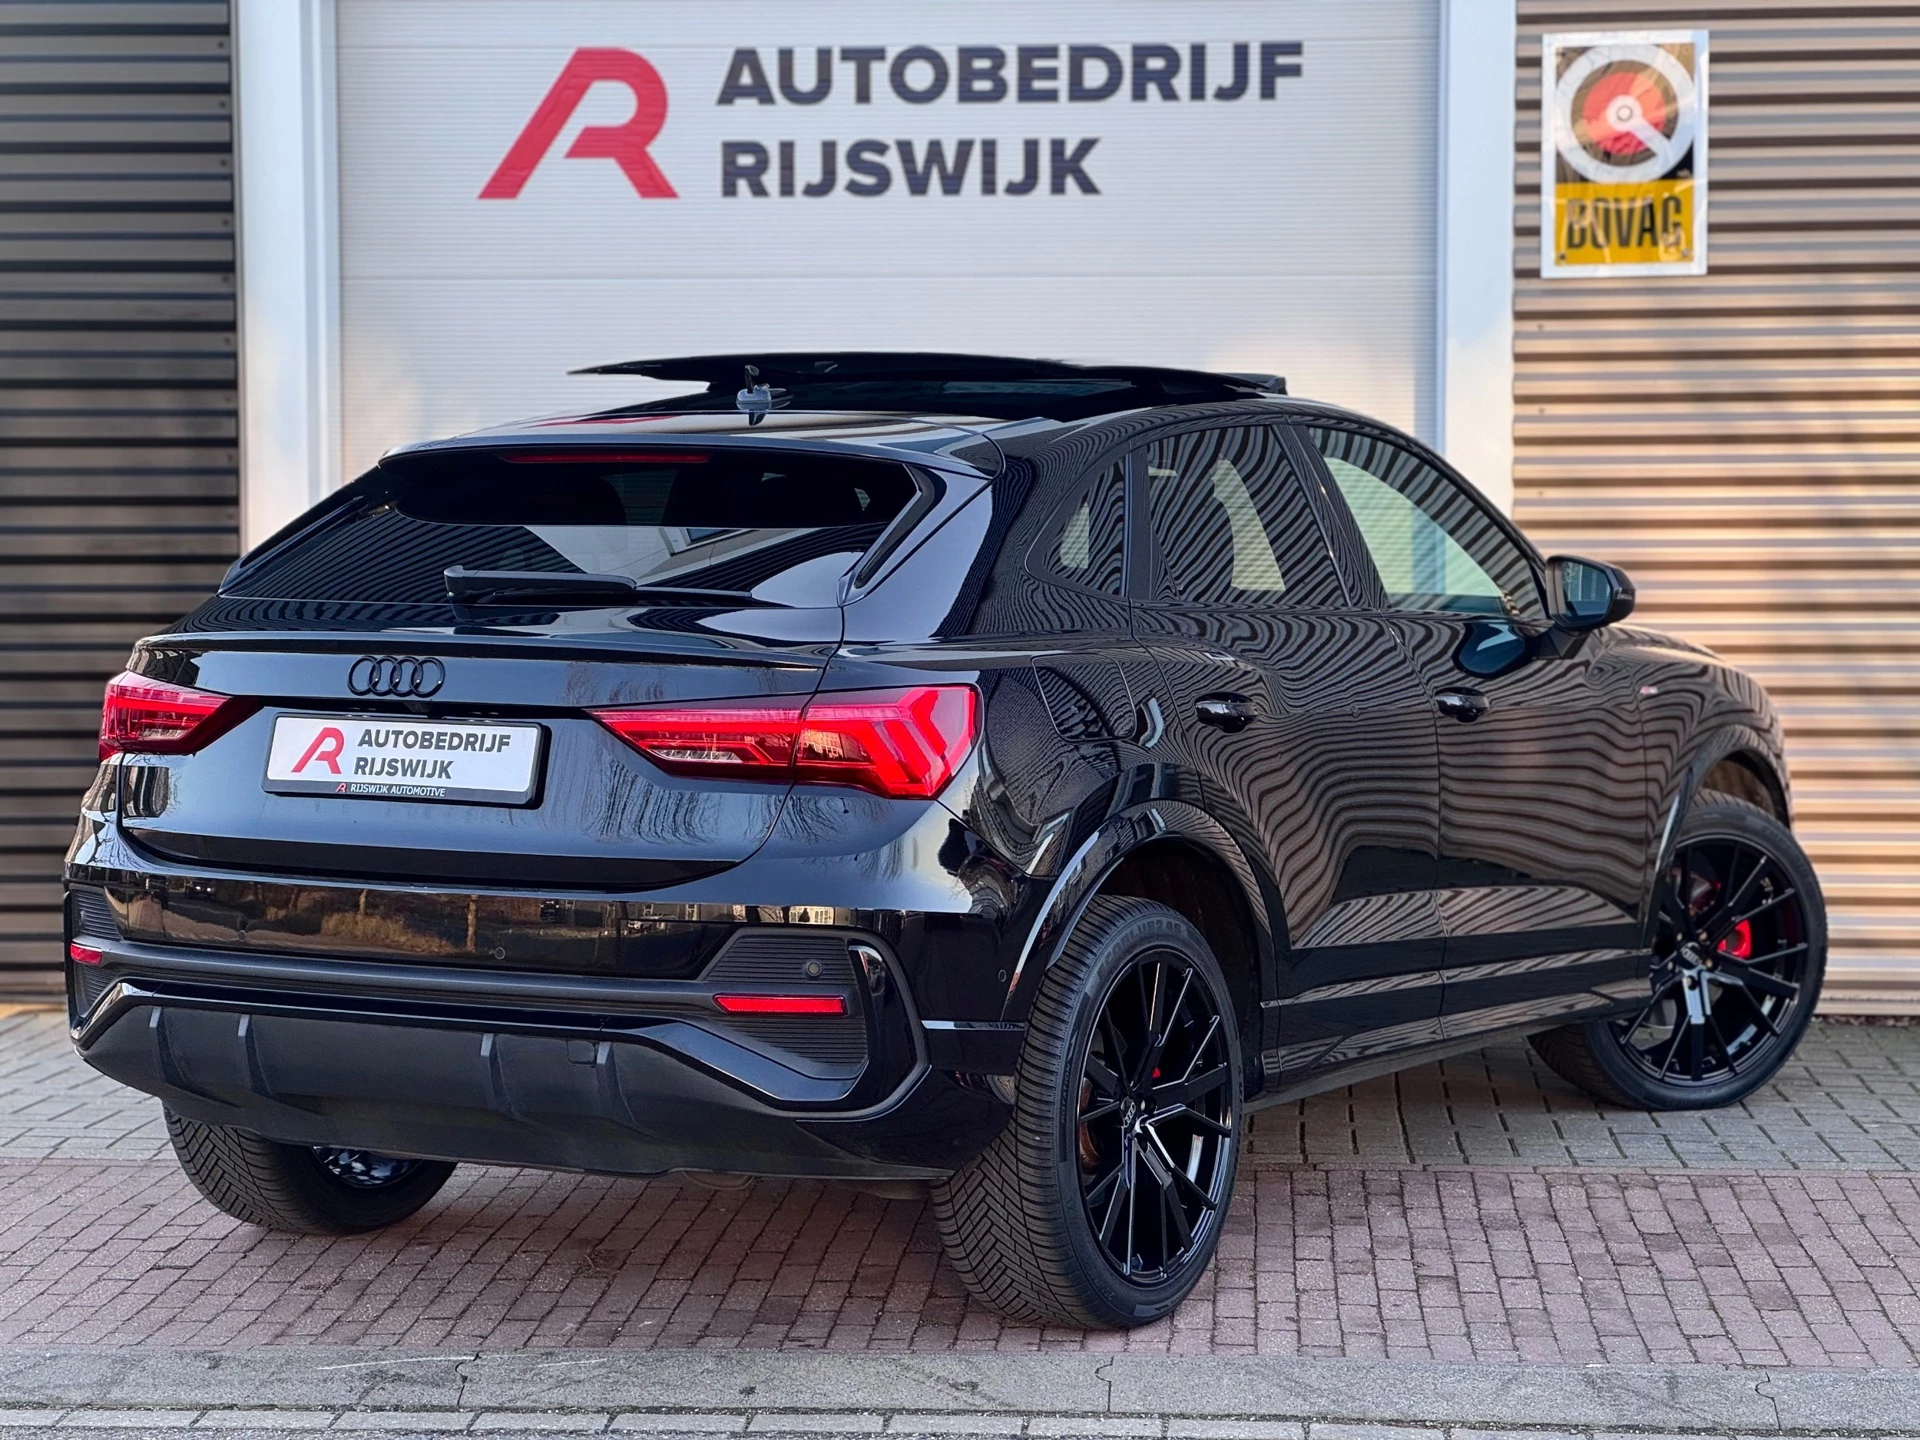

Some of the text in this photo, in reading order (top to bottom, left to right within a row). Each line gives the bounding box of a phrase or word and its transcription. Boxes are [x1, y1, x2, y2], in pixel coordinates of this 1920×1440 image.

[716, 42, 1303, 106] AUTOBEDRIJF
[720, 138, 1102, 198] RIJSWIJK
[357, 729, 511, 753] AUTOBEDRIJF
[353, 757, 453, 780] RIJSWIJK
[350, 783, 446, 797] RIJSWIJK AUTOMOTIVE
